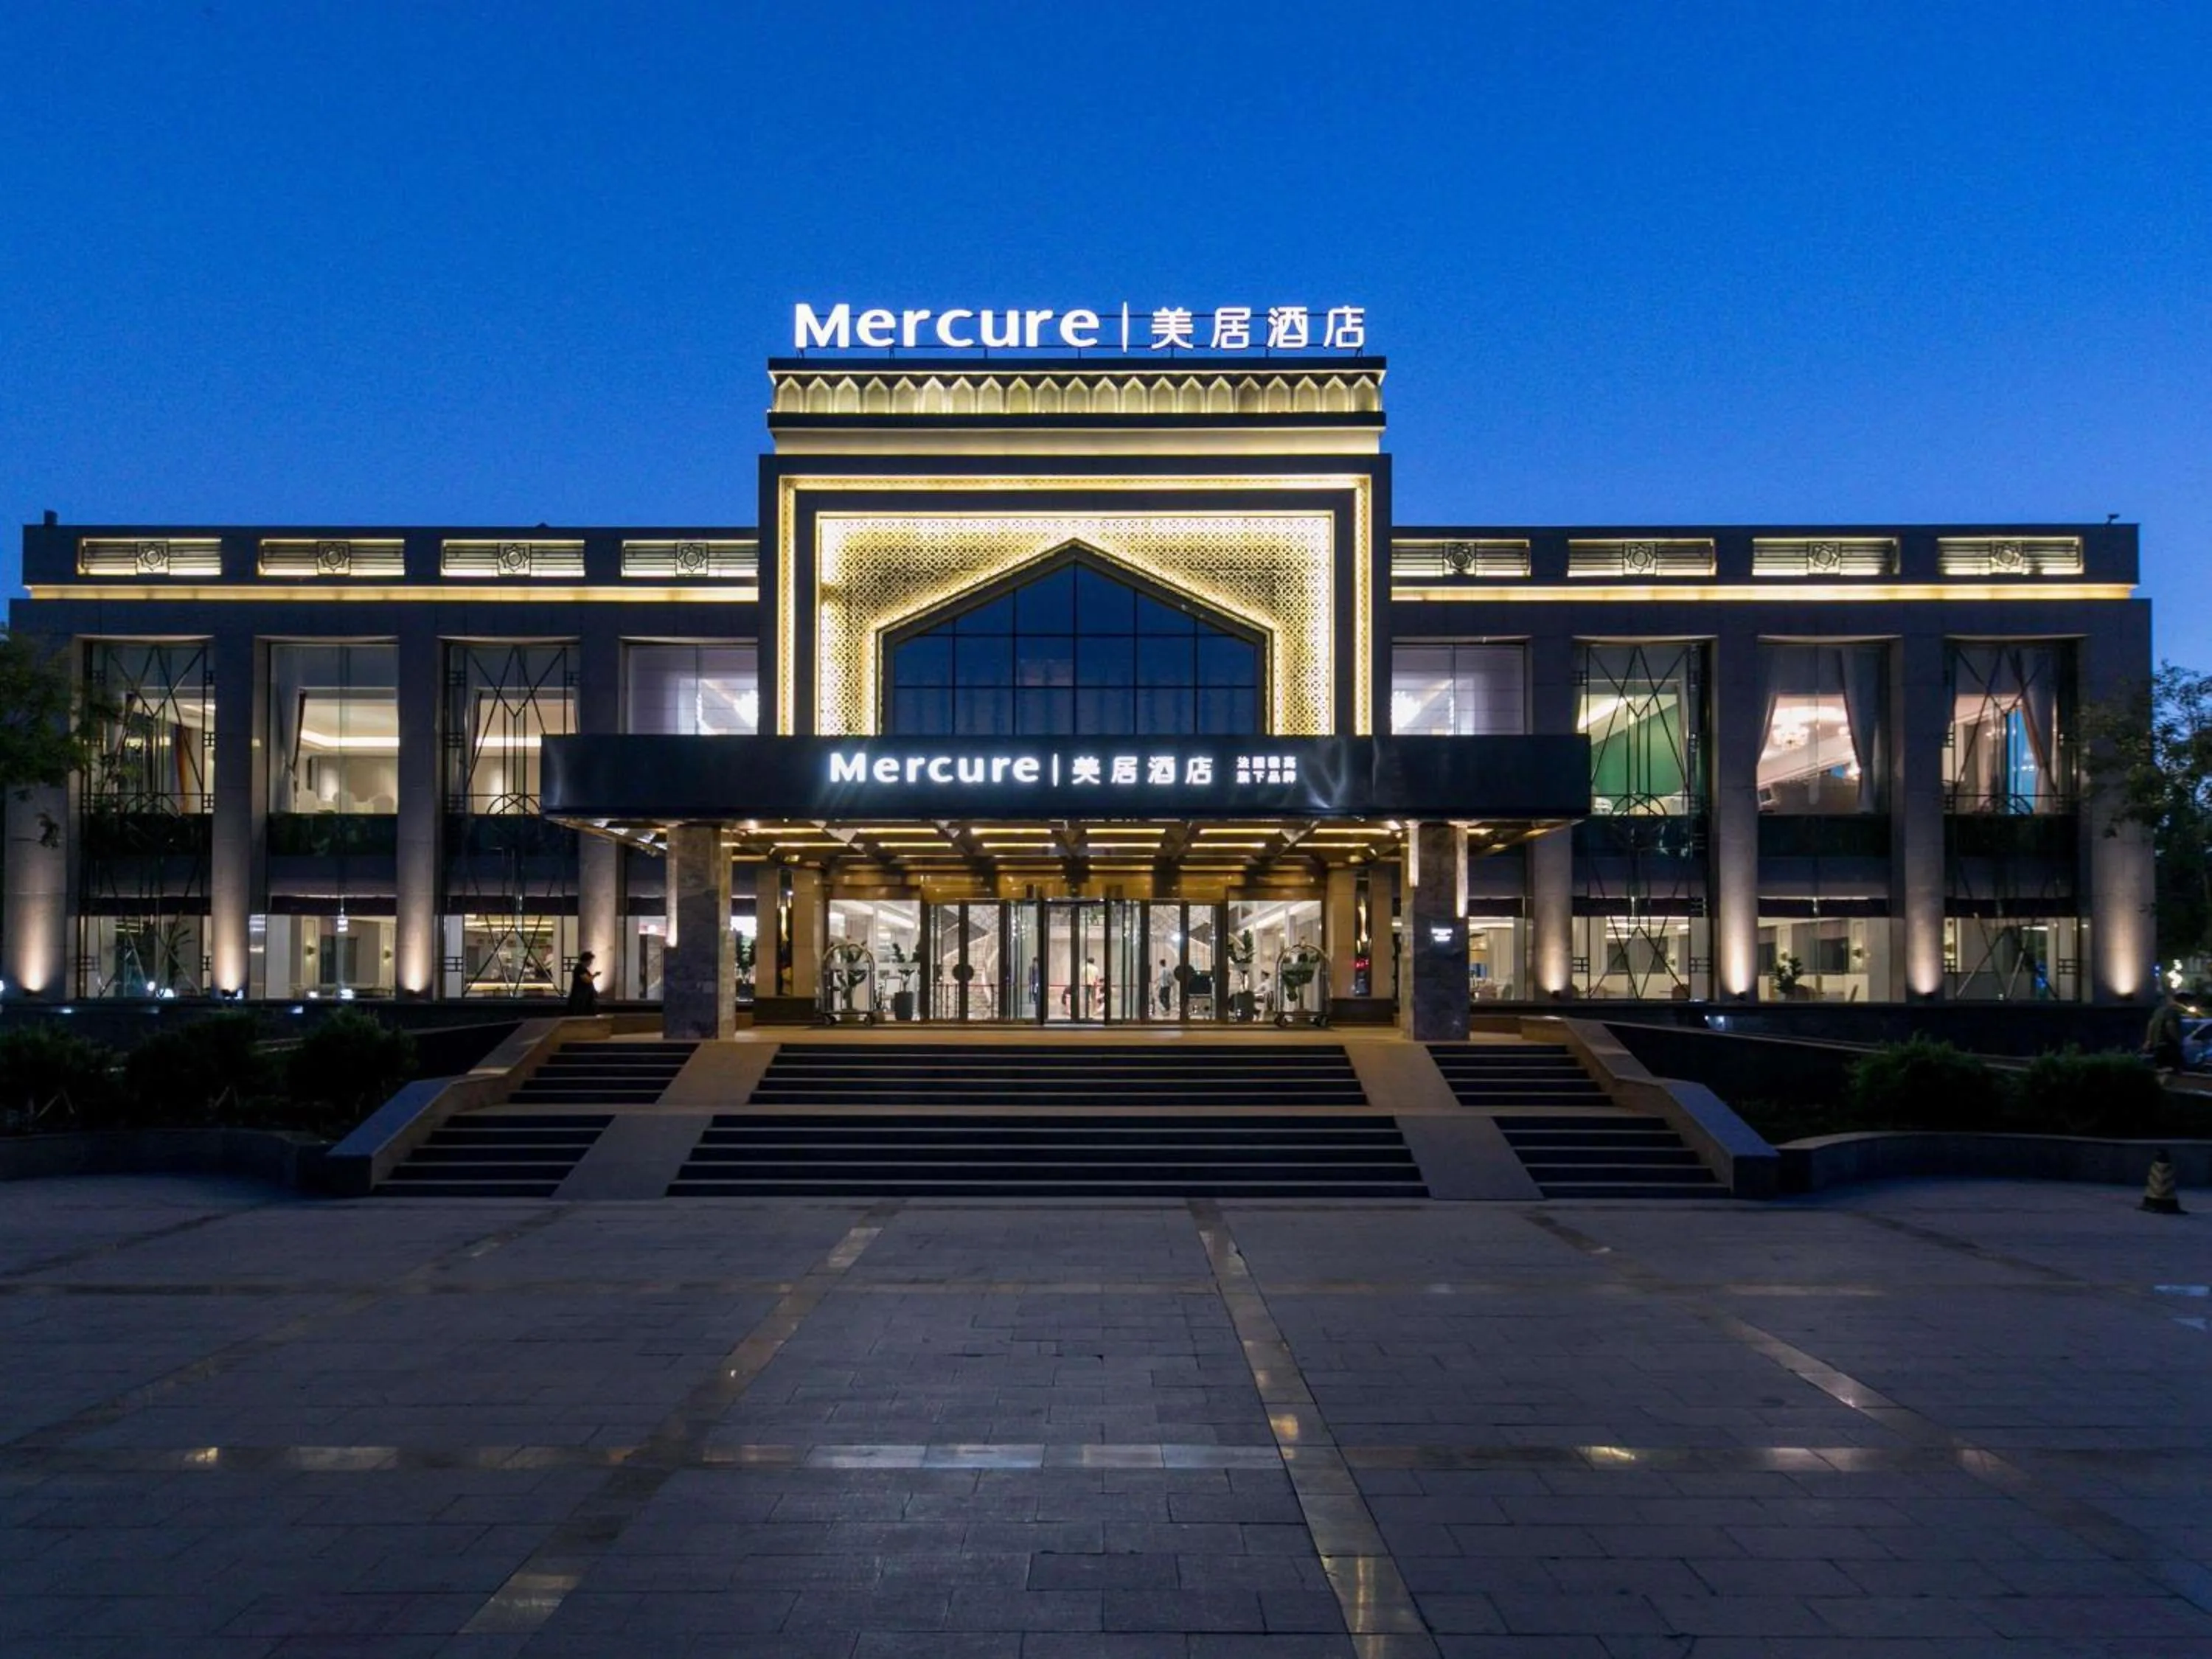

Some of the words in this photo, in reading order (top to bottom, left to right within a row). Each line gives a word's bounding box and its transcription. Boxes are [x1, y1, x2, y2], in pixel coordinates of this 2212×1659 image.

[794, 303, 1099, 348] Mercure
[1151, 305, 1365, 349] 美居酒店
[830, 751, 1040, 784] Mercure
[1071, 755, 1214, 785] 美居酒店
